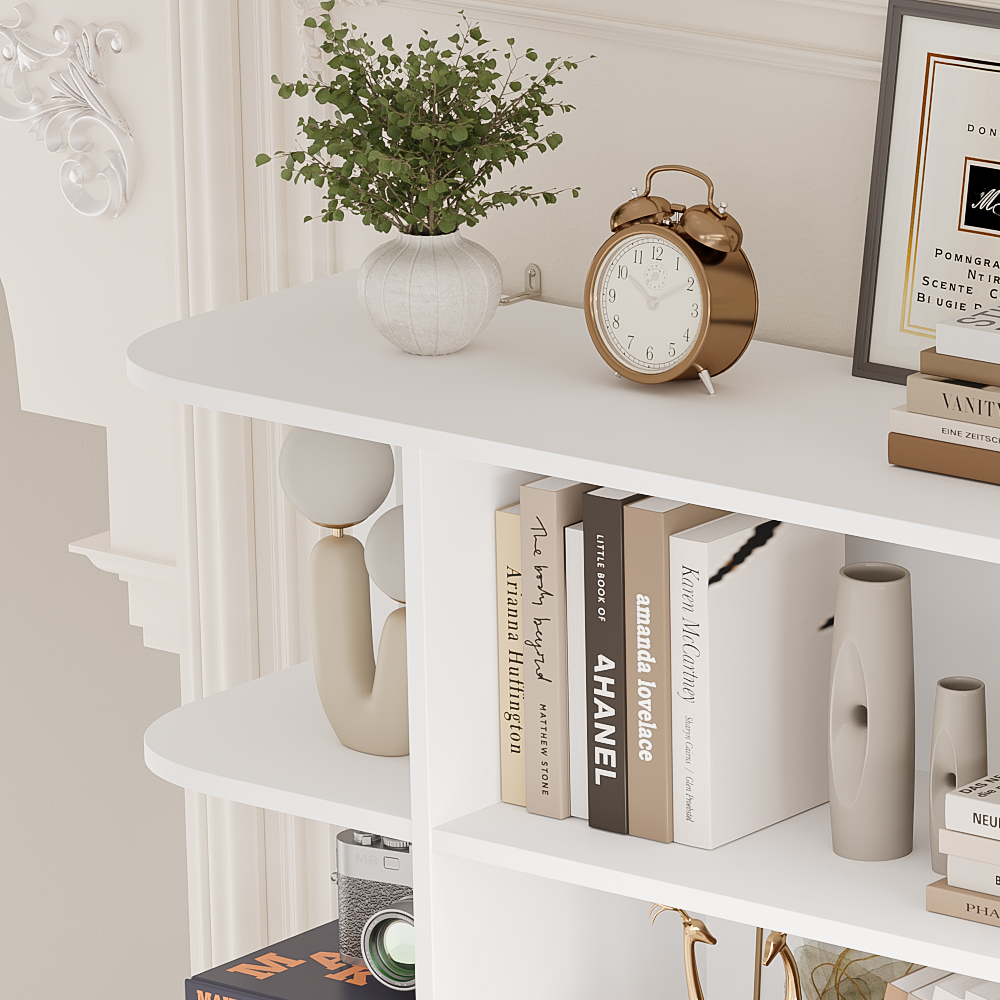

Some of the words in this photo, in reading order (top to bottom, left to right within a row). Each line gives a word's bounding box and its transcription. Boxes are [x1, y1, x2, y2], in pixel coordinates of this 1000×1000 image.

[921, 275, 974, 295] SCENTE
[941, 427, 963, 438] EINE
[530, 516, 548, 557] The
[596, 534, 606, 568] LITTLE
[506, 565, 523, 641] Arianna
[596, 570, 606, 604] BOOK
[681, 564, 700, 614] Karen
[597, 607, 606, 622] OF
[636, 593, 657, 674] amanda
[677, 616, 701, 704] McCartney
[540, 703, 548, 757] MATTHEW
[594, 654, 617, 785] AHANEL
[637, 678, 658, 762] lovelace
[541, 760, 549, 796] STONE
